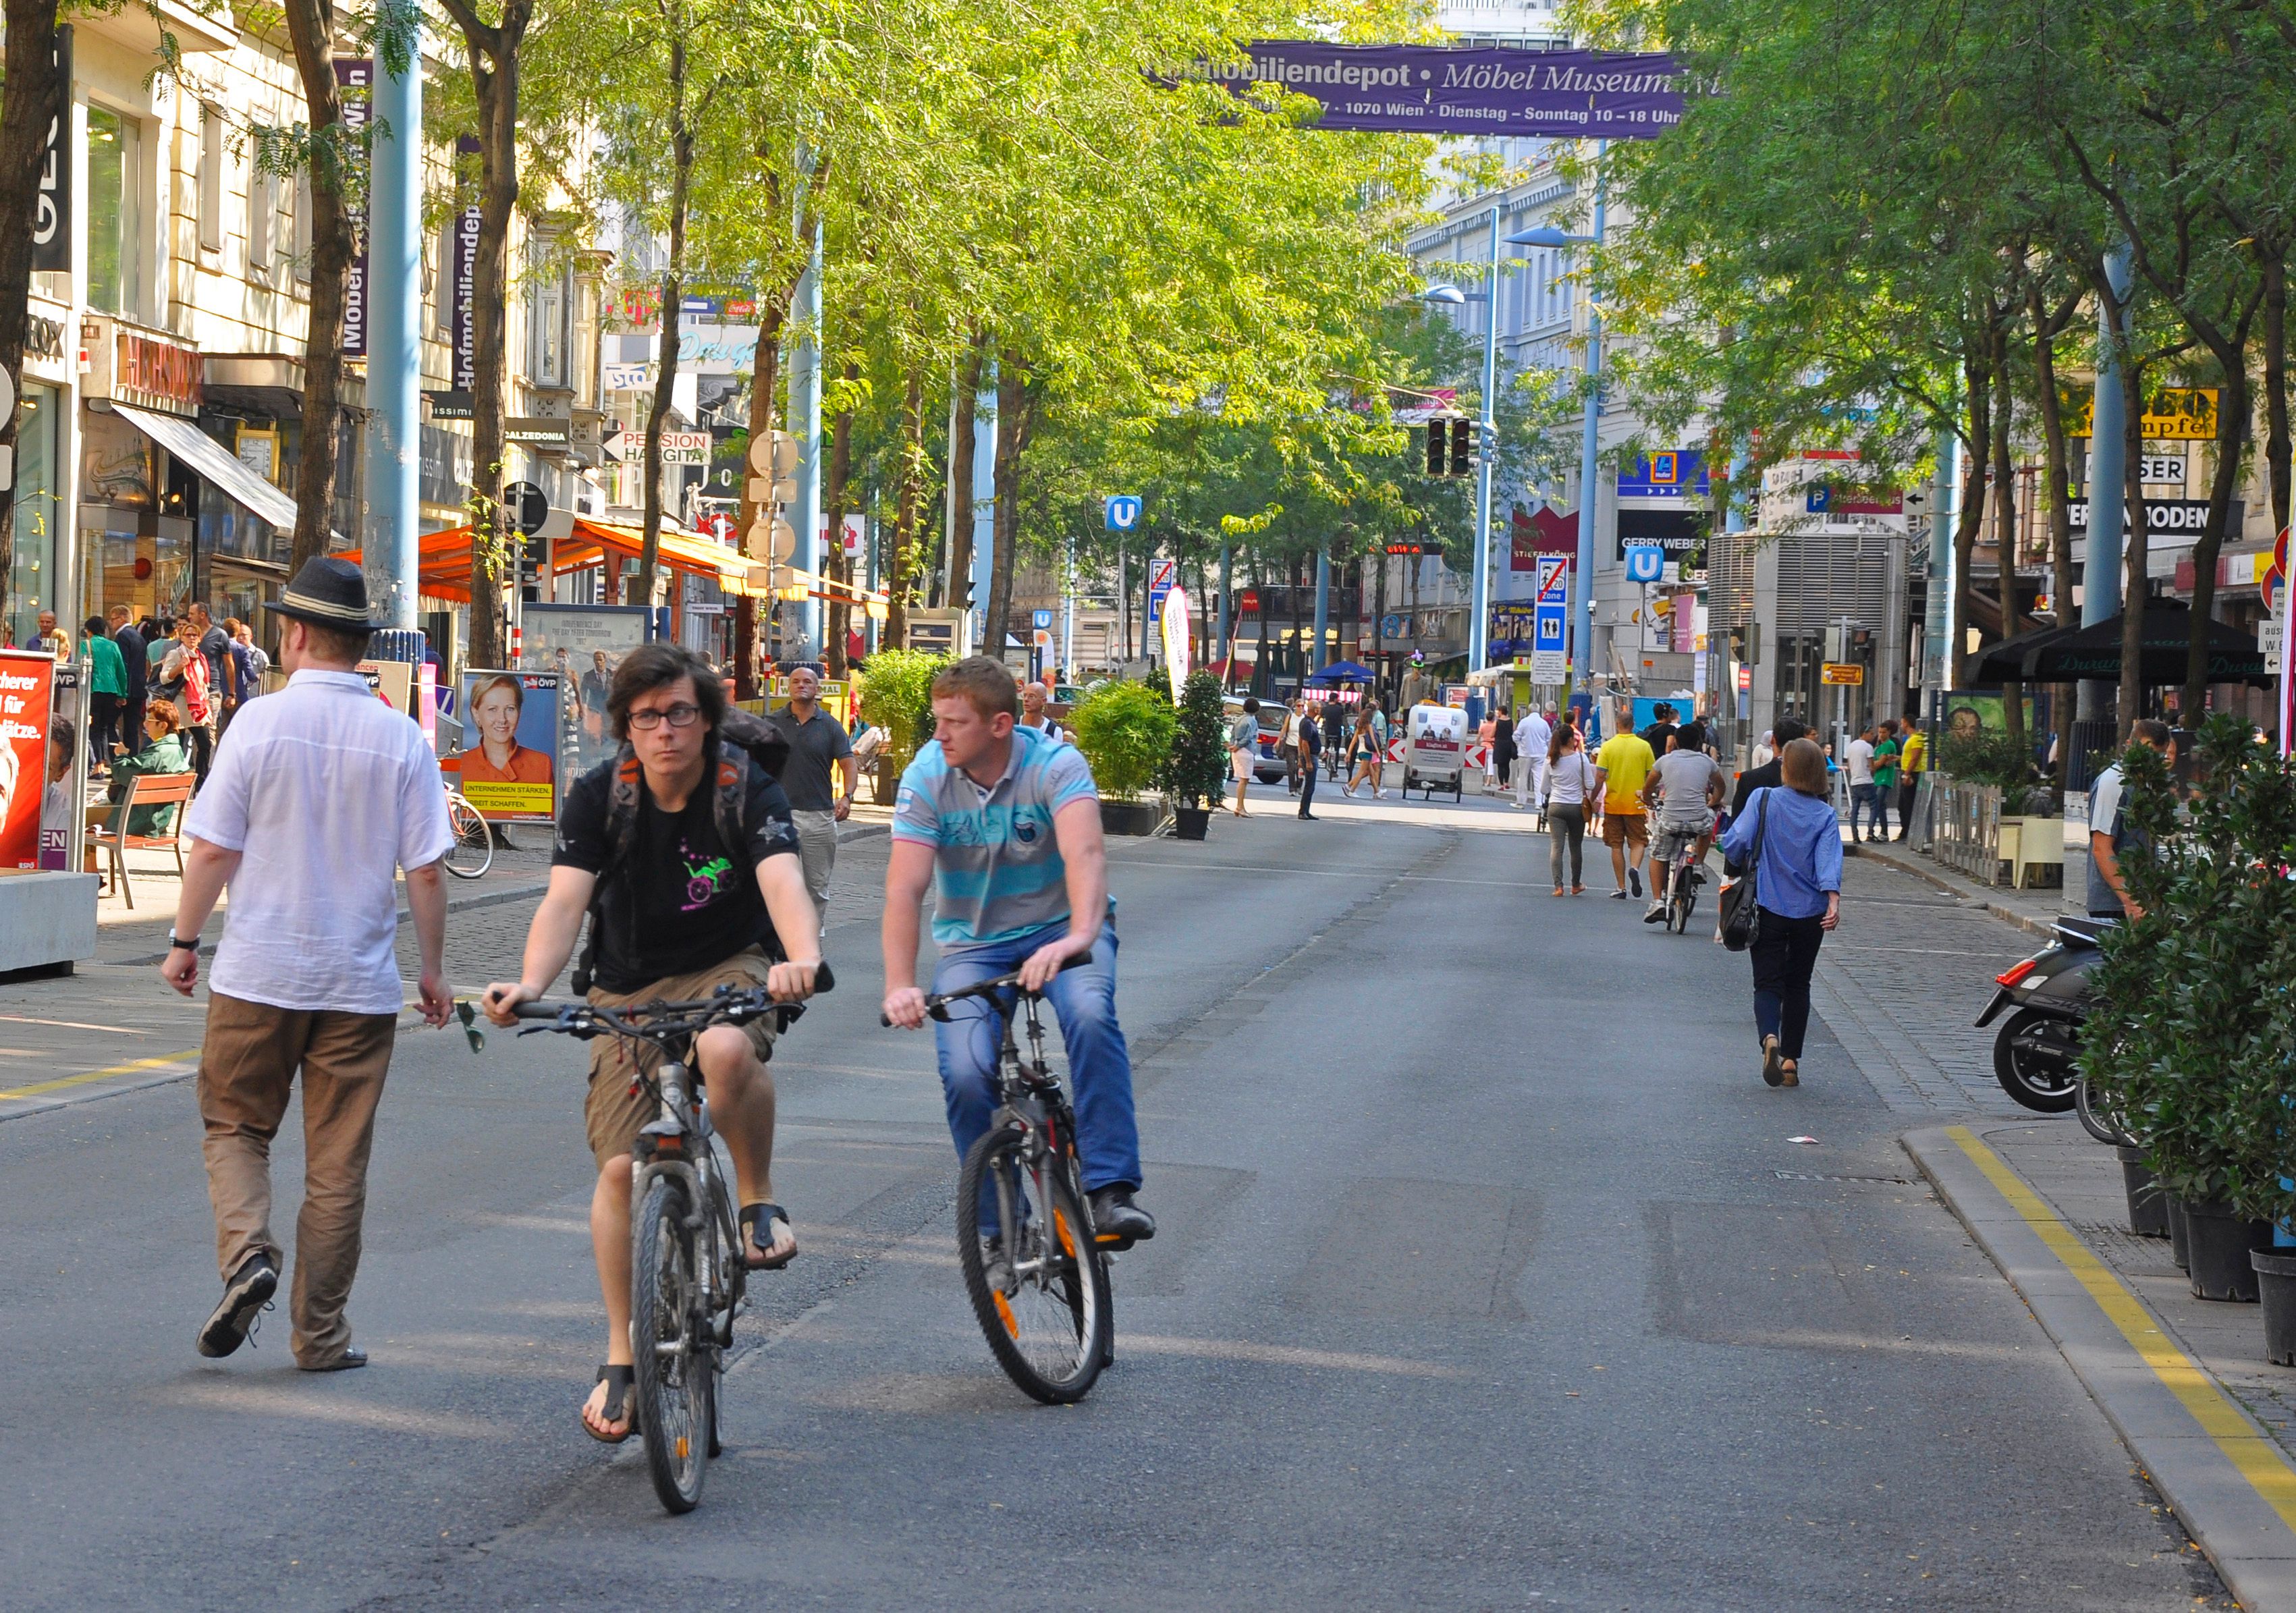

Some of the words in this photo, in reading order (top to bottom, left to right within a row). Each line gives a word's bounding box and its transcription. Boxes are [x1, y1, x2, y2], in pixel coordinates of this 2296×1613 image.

[1440, 63, 1537, 90] Möbel
[1541, 65, 1678, 93] Museum
[1346, 103, 1381, 115] 1070
[1386, 103, 1424, 116] Wien
[1439, 105, 1507, 121] Dienstag
[1524, 107, 1588, 124] Sonntag
[1651, 111, 1680, 123] Uhr
[432, 408, 472, 416] issimi
[624, 433, 706, 448] PESION
[625, 447, 705, 463] HAGITA
[1114, 503, 1135, 527] U
[1622, 537, 1662, 549] GERRY
[1664, 538, 1706, 549] WEBER
[1635, 553, 1658, 578] U
[1554, 580, 1563, 589] 20
[1037, 614, 1049, 627] U
[0, 672, 38, 690] herer
[538, 678, 557, 688] ÖVP
[465, 785, 516, 793] UNTERNEHMEN
[517, 786, 550, 794] STÄRKEN.
